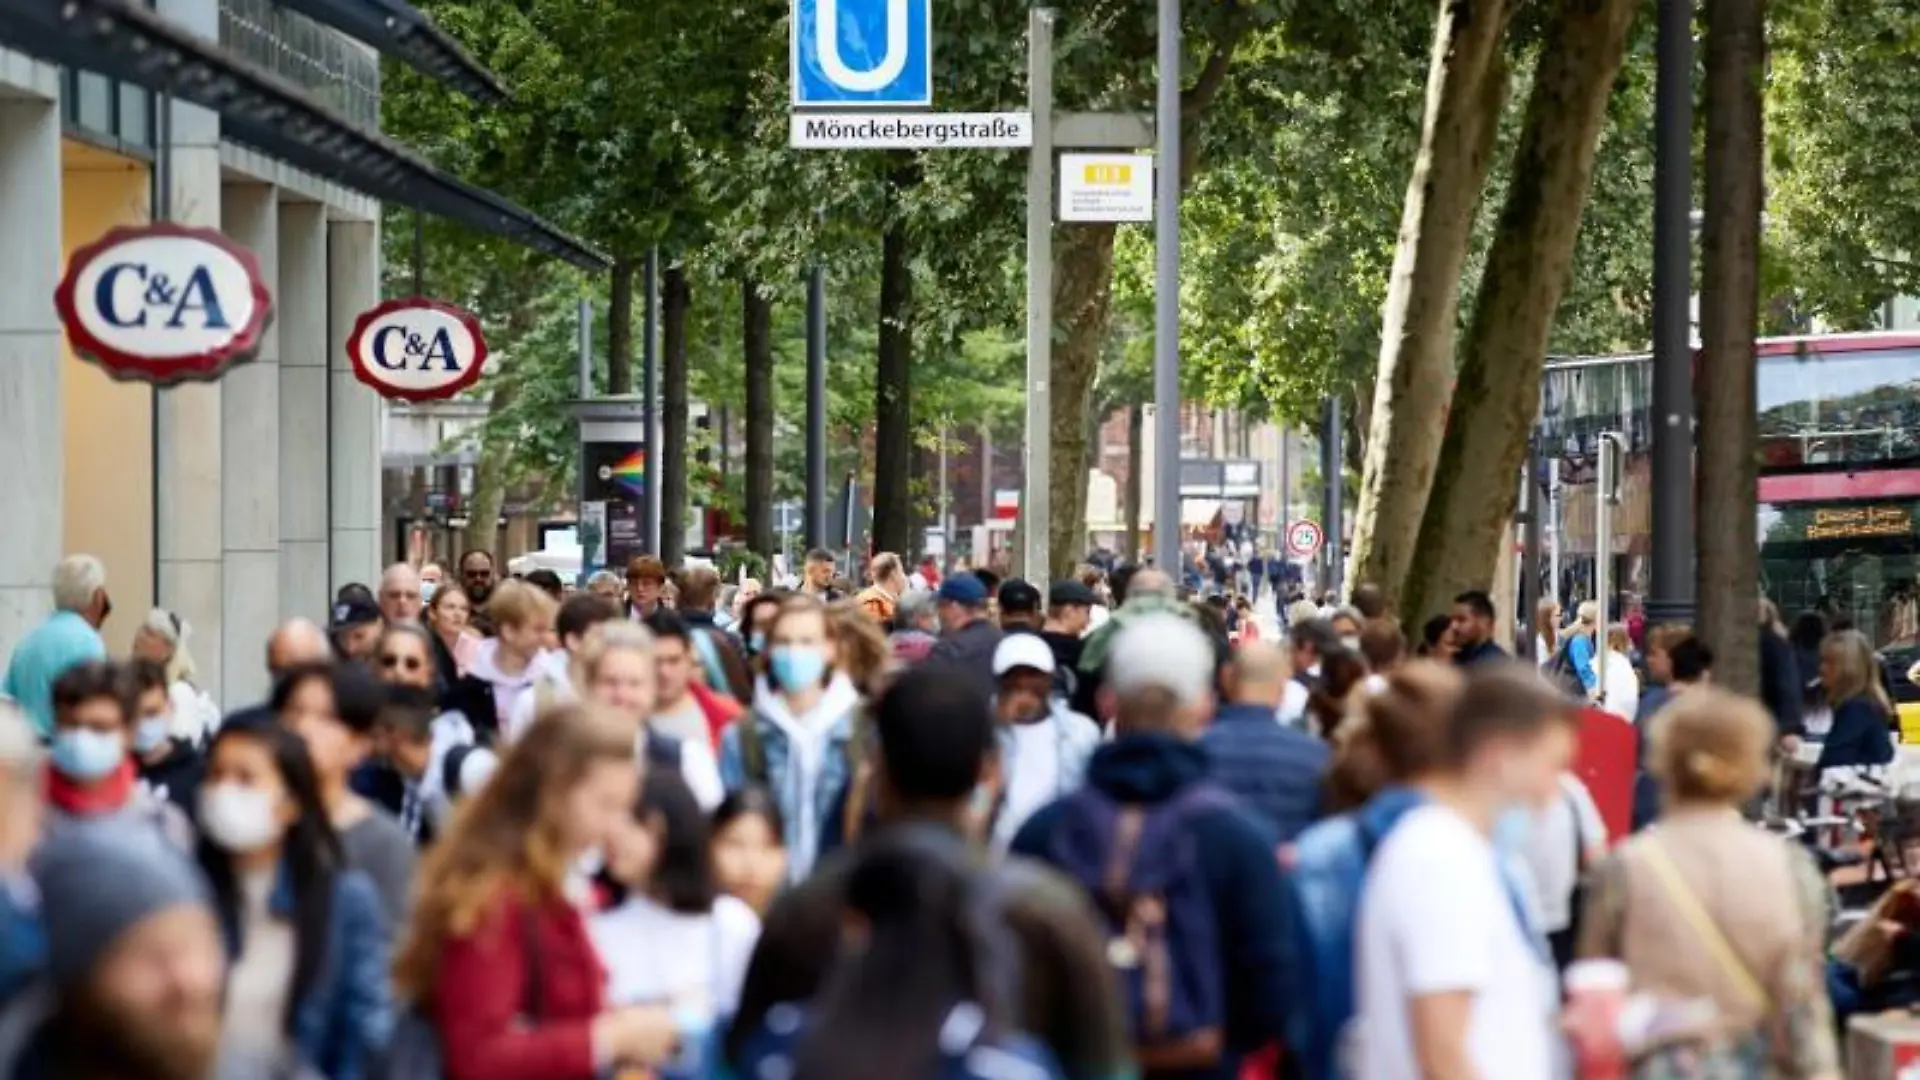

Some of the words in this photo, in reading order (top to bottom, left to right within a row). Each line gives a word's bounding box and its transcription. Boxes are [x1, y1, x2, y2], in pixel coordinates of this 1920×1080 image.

[805, 119, 1020, 144] Mönckebergstraße
[94, 262, 231, 329] C&A
[372, 325, 462, 371] C&A
[1296, 530, 1313, 545] 25
